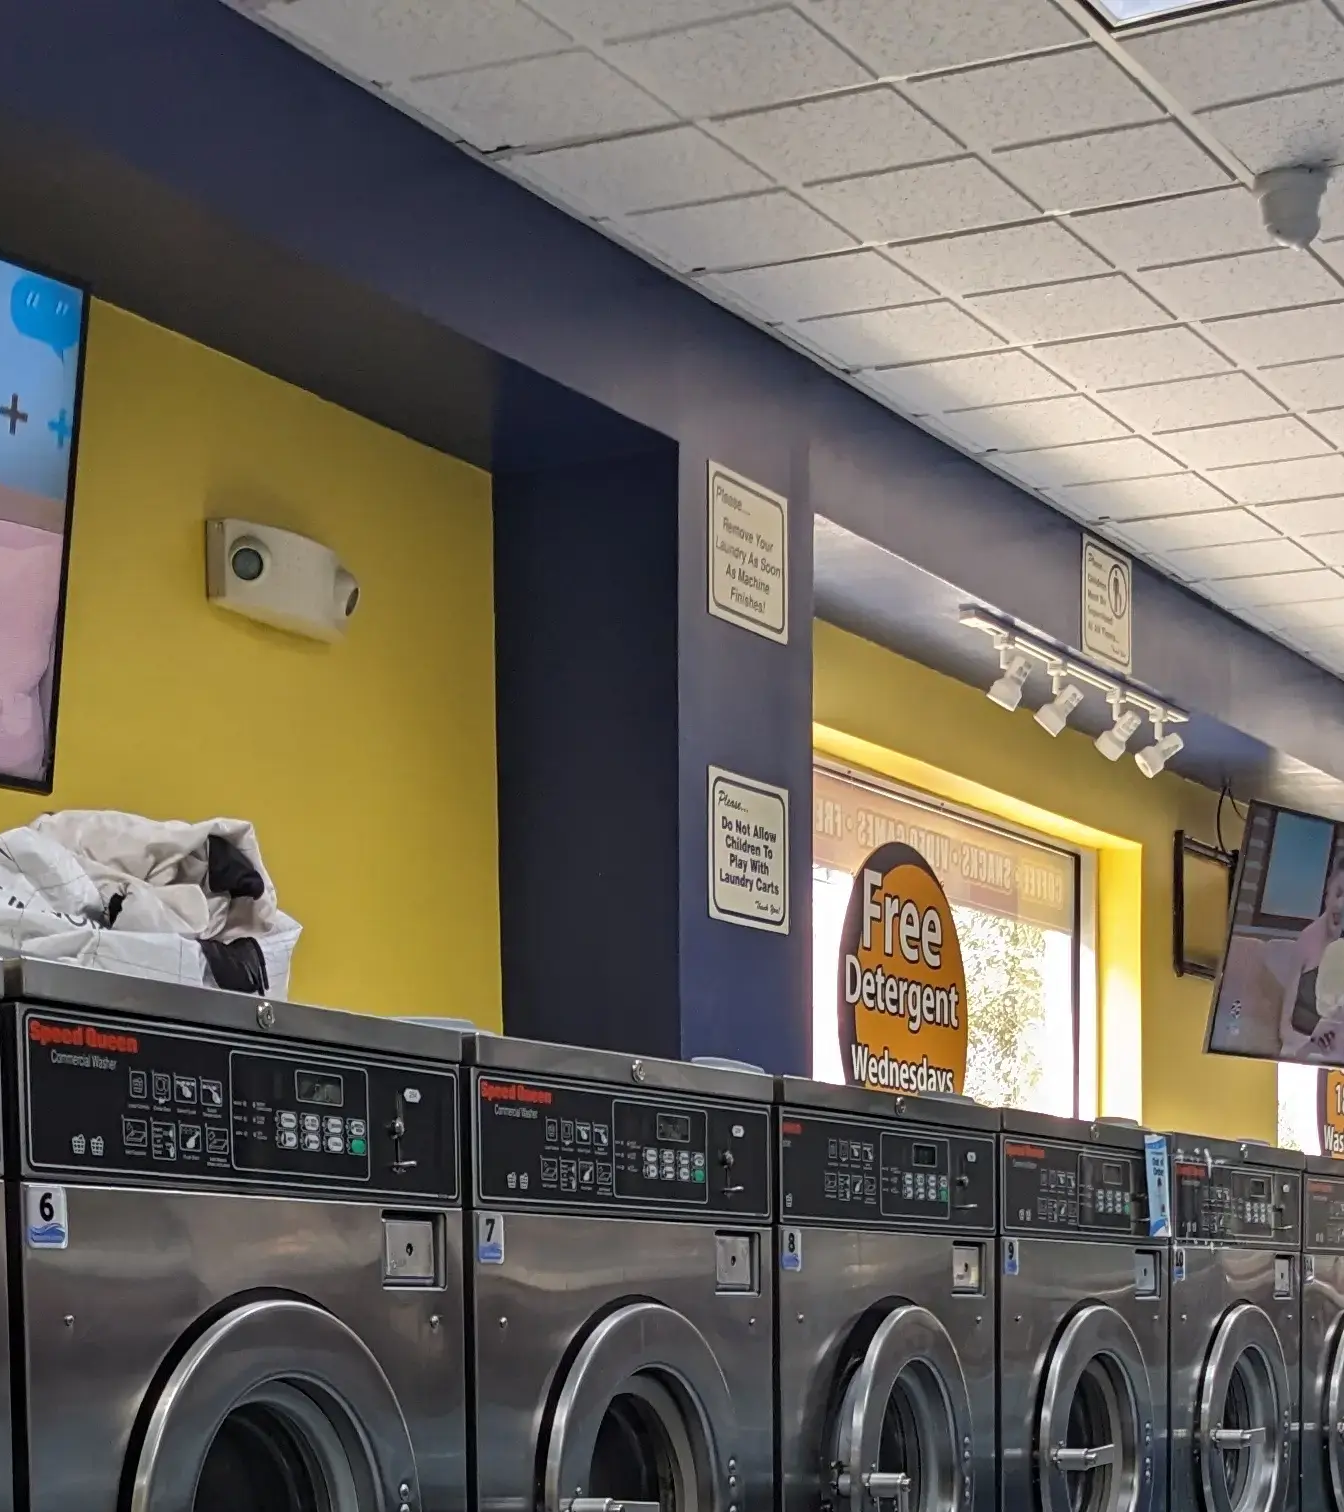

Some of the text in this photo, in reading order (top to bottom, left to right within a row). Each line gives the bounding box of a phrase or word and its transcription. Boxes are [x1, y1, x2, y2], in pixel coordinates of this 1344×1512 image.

[723, 516, 774, 553] Remove Your
[715, 535, 781, 579] Laundry As Soon
[725, 563, 770, 596] As Machine
[730, 586, 767, 614] Finishes!
[721, 816, 777, 844] Do Not Allow
[725, 834, 773, 860] Children To
[729, 853, 769, 877] Play With
[719, 868, 780, 896] Laundry Carts
[862, 868, 942, 968] Free
[845, 953, 959, 1033] Detergent
[30, 1020, 139, 1053] Speed Queen
[51, 1049, 117, 1071] Commercial Washer
[851, 1043, 954, 1094] Wednesdays
[40, 1192, 54, 1222] 6
[485, 1218, 495, 1242] 7
[788, 1232, 795, 1253] 8
[1008, 1241, 1015, 1260] 9
